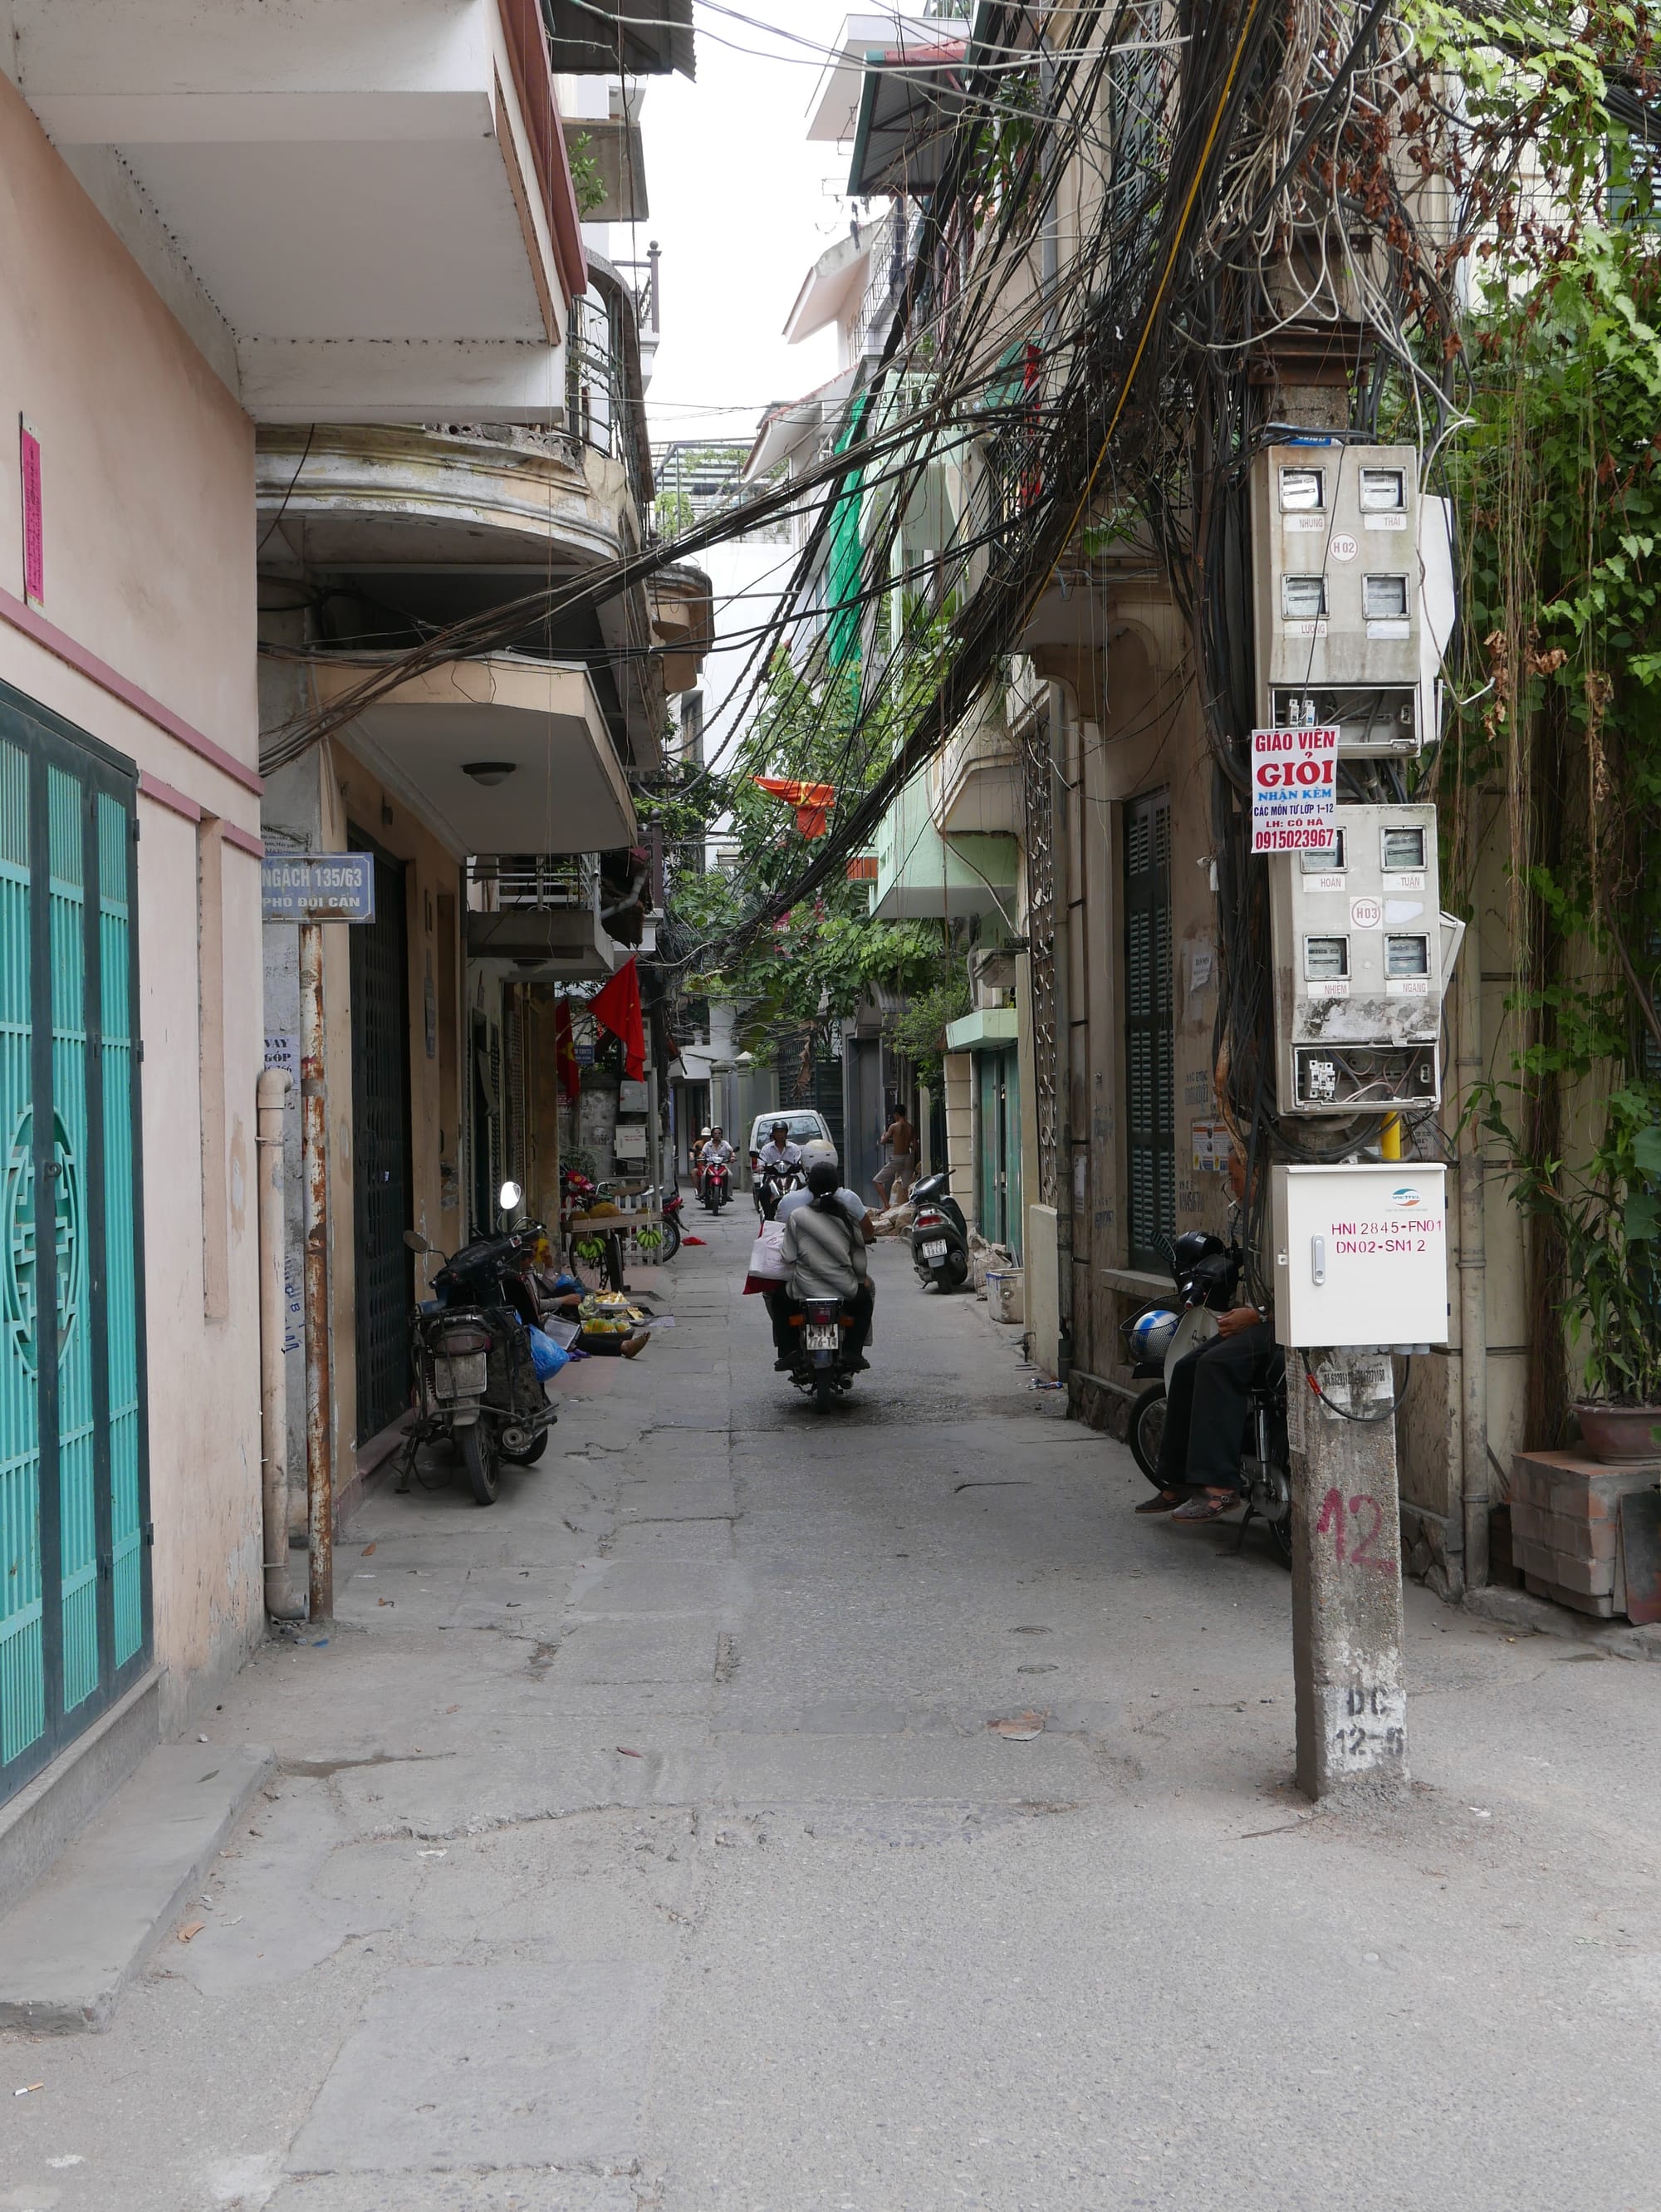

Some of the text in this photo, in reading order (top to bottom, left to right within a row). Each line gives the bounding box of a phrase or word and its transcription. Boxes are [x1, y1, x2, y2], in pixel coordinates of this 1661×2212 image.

[1255, 728, 1335, 753] GIÁO VIÊN
[1257, 751, 1334, 787] GIỎI
[1258, 788, 1298, 802] NHẬN
[1254, 804, 1269, 817] CÁC
[1271, 803, 1288, 816] MÔN
[1301, 801, 1315, 814] LỚP
[1316, 802, 1334, 814] 1-12
[1287, 818, 1303, 826] CÔ
[1256, 829, 1334, 849] 0915023967
[262, 864, 362, 887] NGÁCH 135/63
[262, 893, 293, 907] PHỐ
[298, 895, 324, 911] ĐỘI
[264, 1051, 292, 1062] GÓP
[1316, 1488, 1396, 1572] 12
